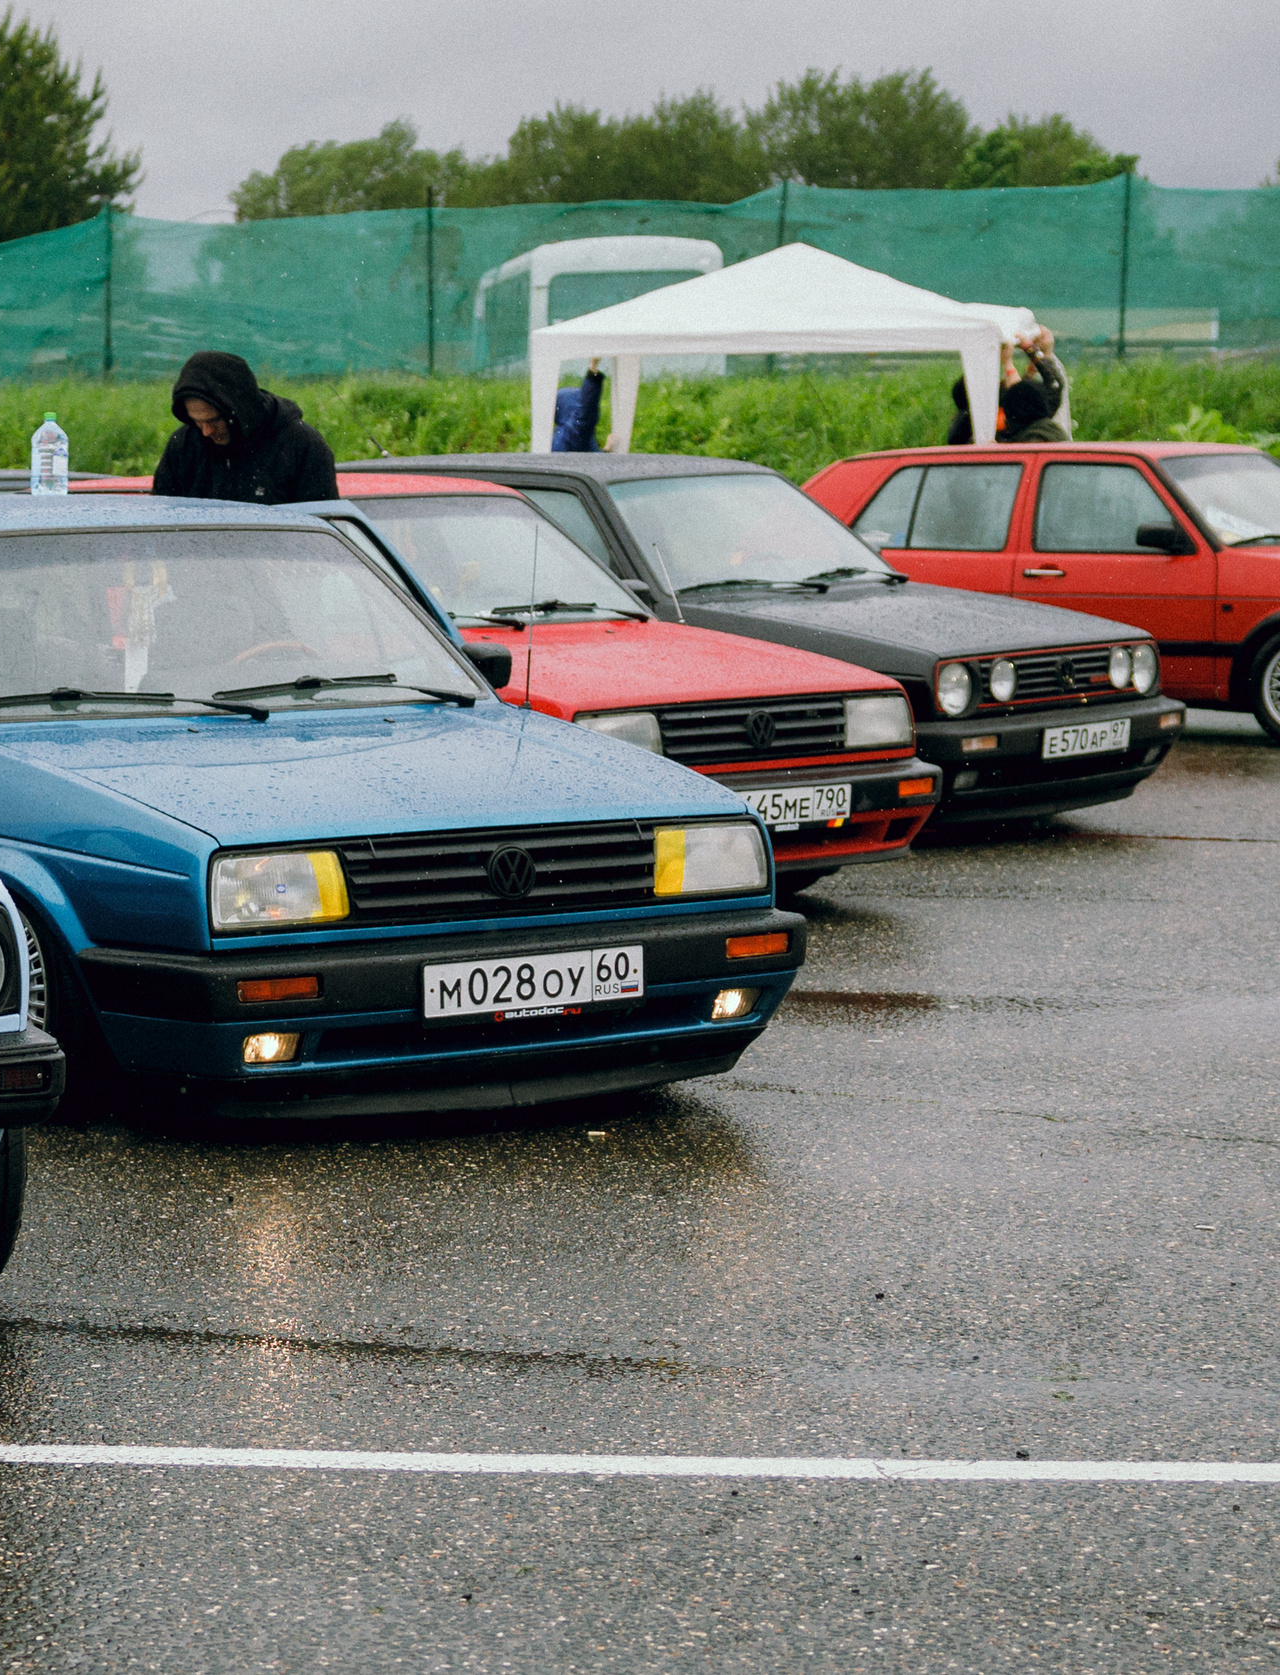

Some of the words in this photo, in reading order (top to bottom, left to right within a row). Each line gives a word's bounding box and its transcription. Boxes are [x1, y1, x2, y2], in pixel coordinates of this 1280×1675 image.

[1048, 728, 1108, 754] E570AP
[747, 793, 811, 820] 45ME
[815, 787, 846, 810] 790
[492, 848, 534, 897] VW
[439, 963, 585, 1009] M028OY
[596, 951, 630, 982] 60
[594, 983, 619, 996] RUS
